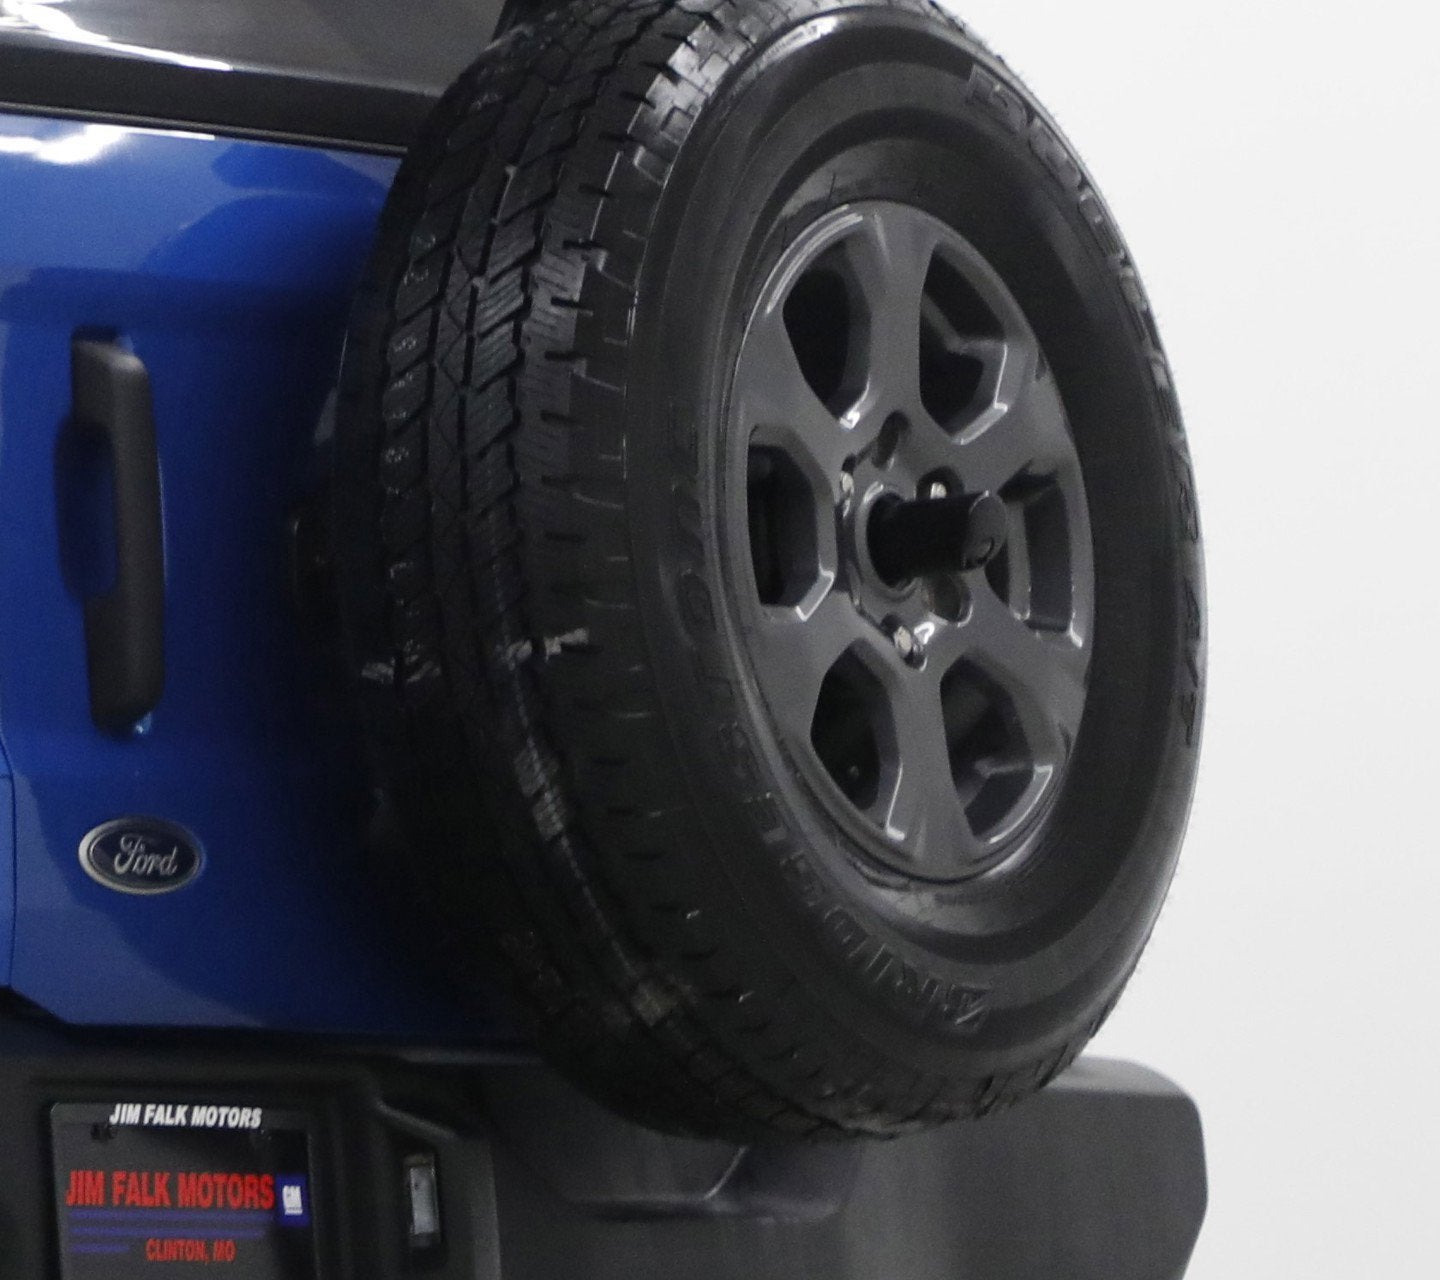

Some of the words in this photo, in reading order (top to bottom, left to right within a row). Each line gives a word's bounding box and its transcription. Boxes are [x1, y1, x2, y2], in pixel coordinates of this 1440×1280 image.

[114, 834, 178, 875] Ford
[109, 1103, 140, 1125] JIM
[143, 1104, 189, 1127] FALK
[191, 1106, 262, 1129] MOTORS
[66, 1170, 105, 1206] JIM
[111, 1171, 171, 1207] FALK
[178, 1173, 275, 1210] MOTORS
[145, 1239, 210, 1265] CLINTON,
[213, 1240, 237, 1262] MO
